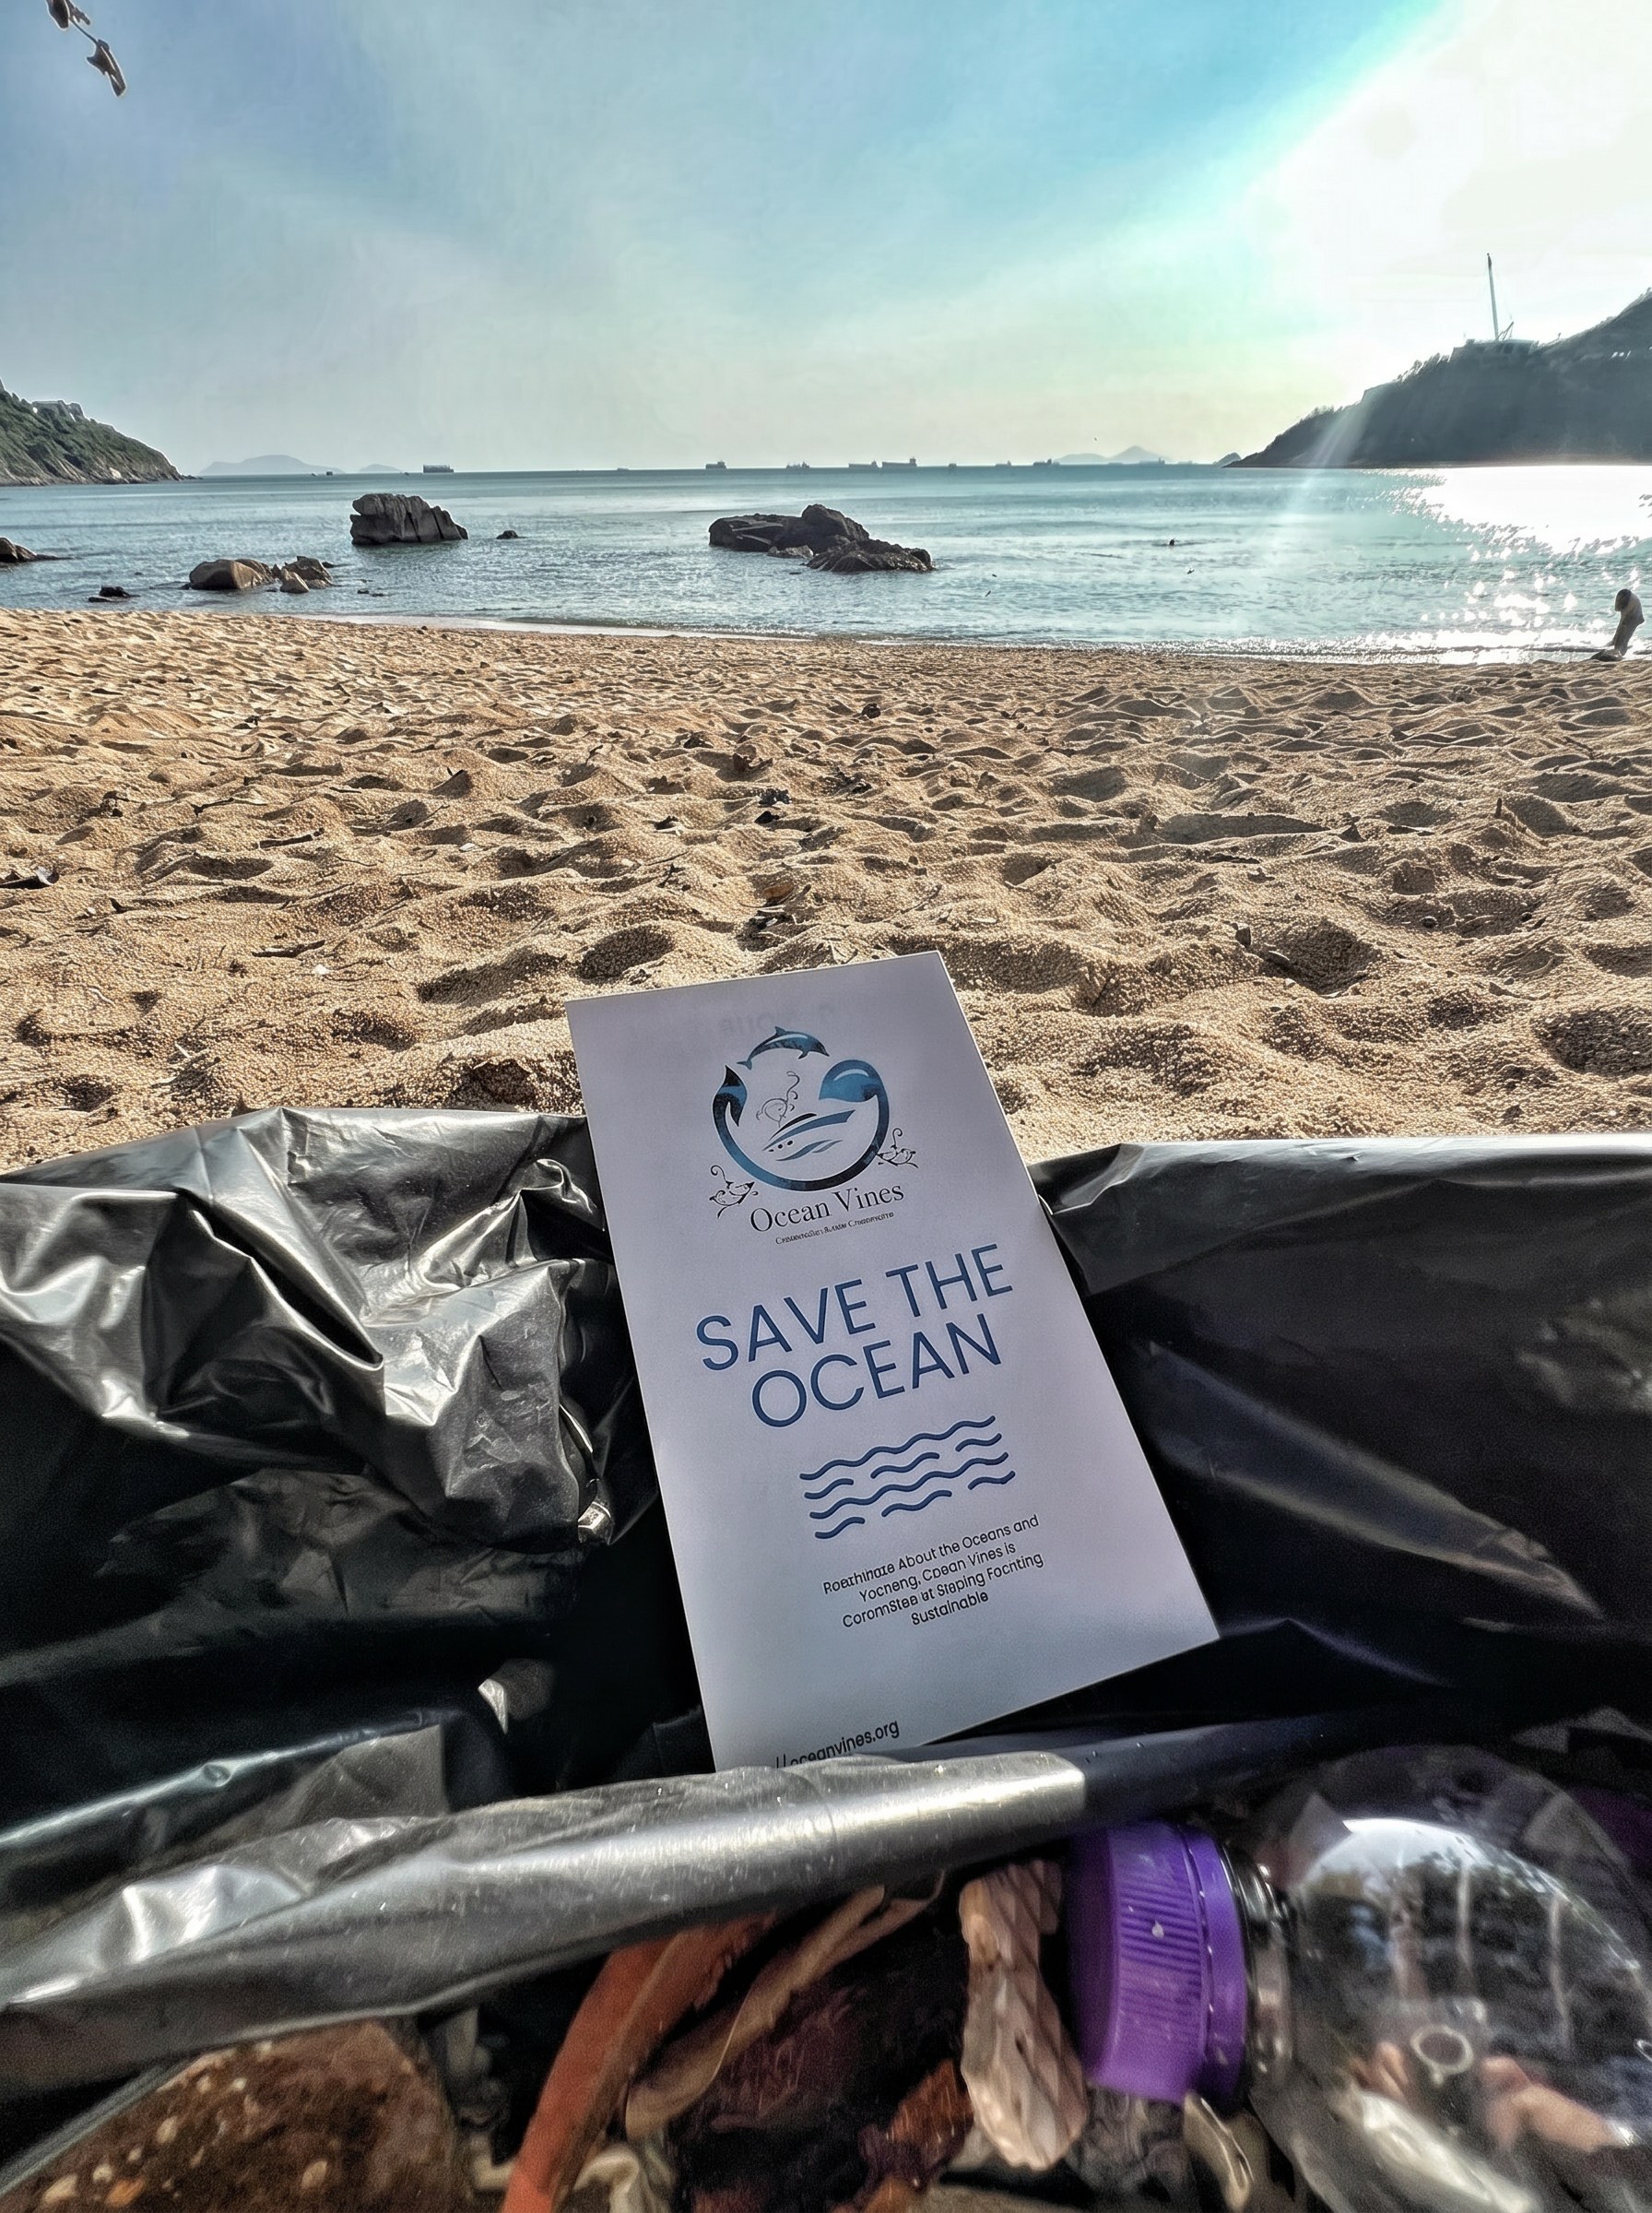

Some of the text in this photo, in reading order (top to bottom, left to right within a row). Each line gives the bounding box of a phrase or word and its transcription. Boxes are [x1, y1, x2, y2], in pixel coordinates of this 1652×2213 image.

[749, 1200, 832, 1232] Ocean
[832, 1185, 905, 1213] Vines
[696, 1243, 1013, 1371] SAVE THE
[751, 1313, 1002, 1427] OCEAN
[899, 1548, 937, 1570] About
[938, 1542, 961, 1557] the
[962, 1526, 1011, 1548] Oceans
[1013, 1513, 1039, 1533] and
[967, 1547, 1003, 1567] Vines
[1004, 1543, 1016, 1555] is
[911, 1591, 989, 1626] Sustainable
